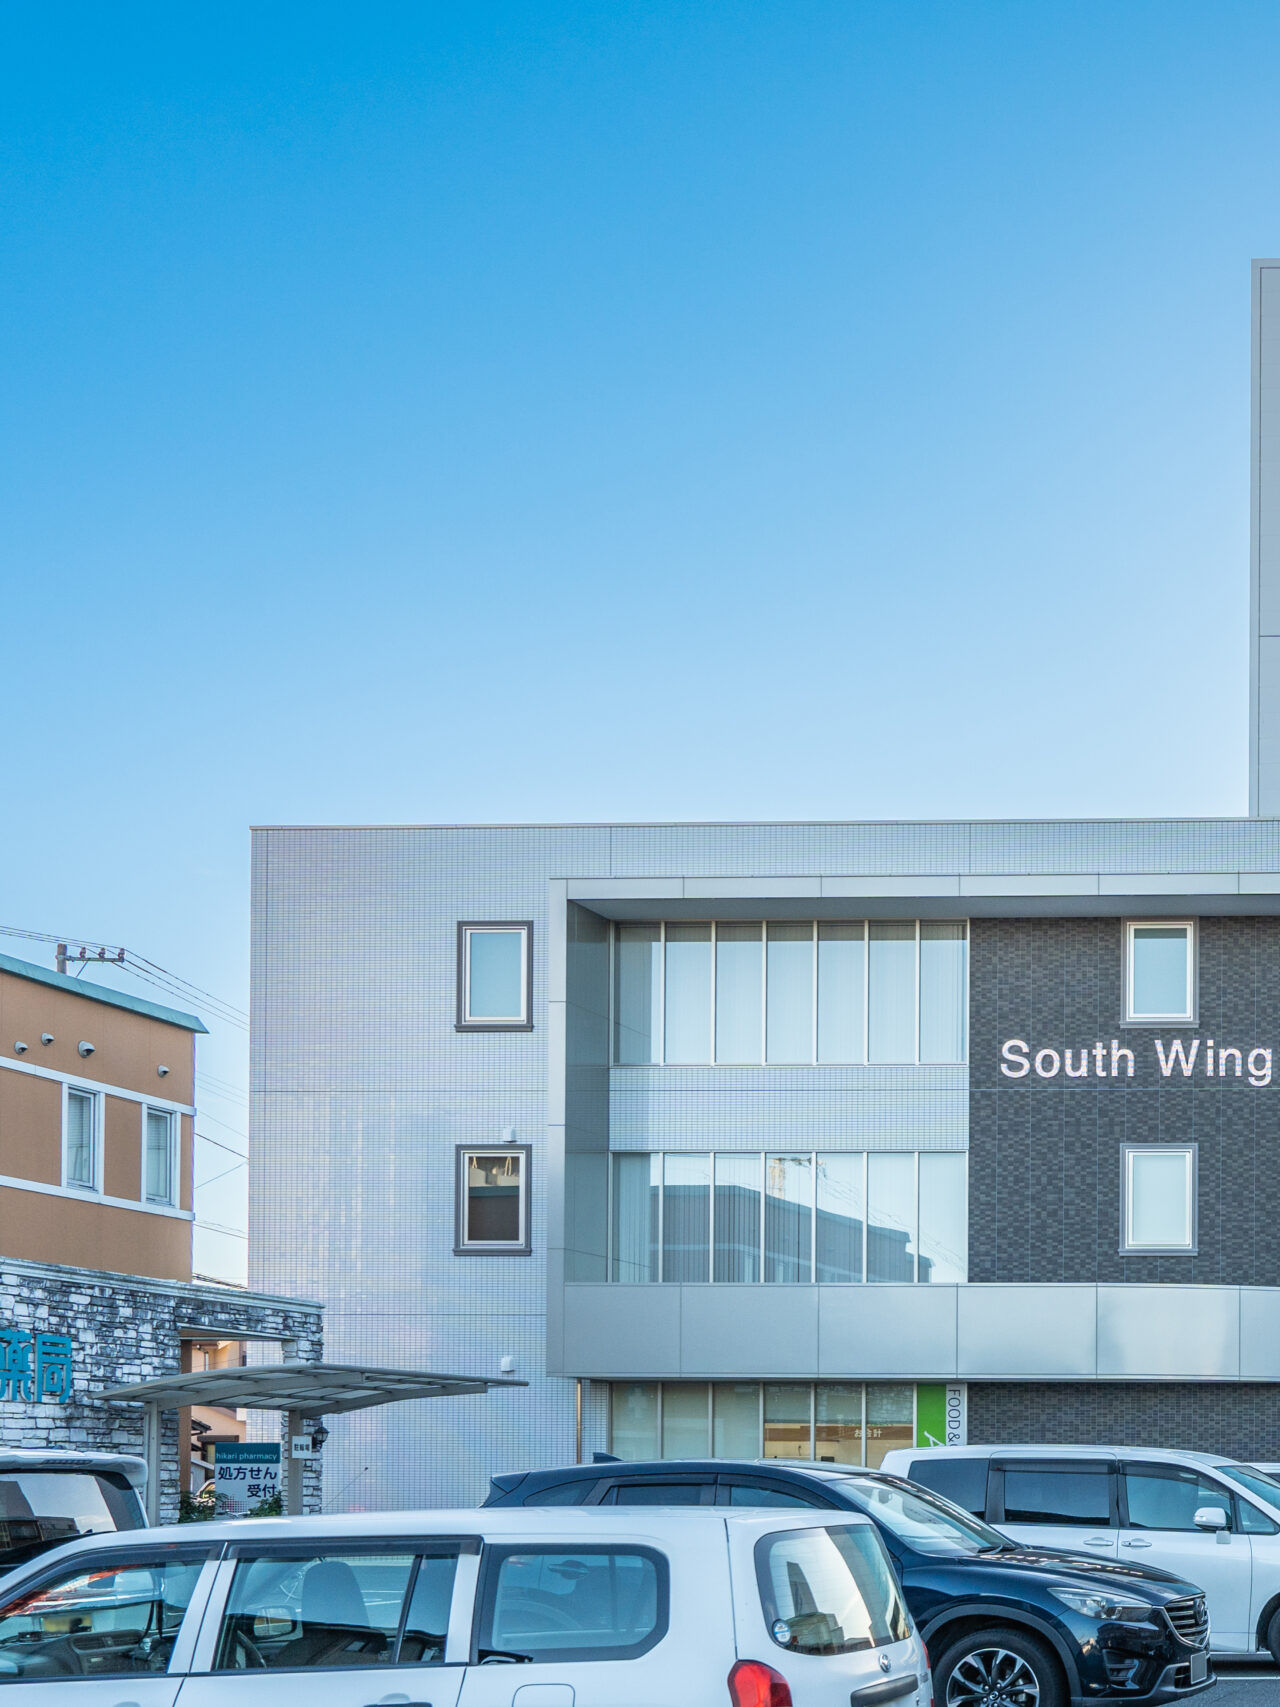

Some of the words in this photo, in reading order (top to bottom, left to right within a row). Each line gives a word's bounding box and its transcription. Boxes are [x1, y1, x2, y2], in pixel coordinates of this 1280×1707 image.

[1000, 1039, 1135, 1078] South
[1154, 1039, 1273, 1087] Wing
[948, 1389, 961, 1430] FOOD
[948, 1432, 961, 1442] &
[216, 1452, 238, 1460] hikari
[239, 1452, 278, 1462] pharmacy
[218, 1466, 277, 1480] 処方せん
[247, 1484, 277, 1498] 受付
